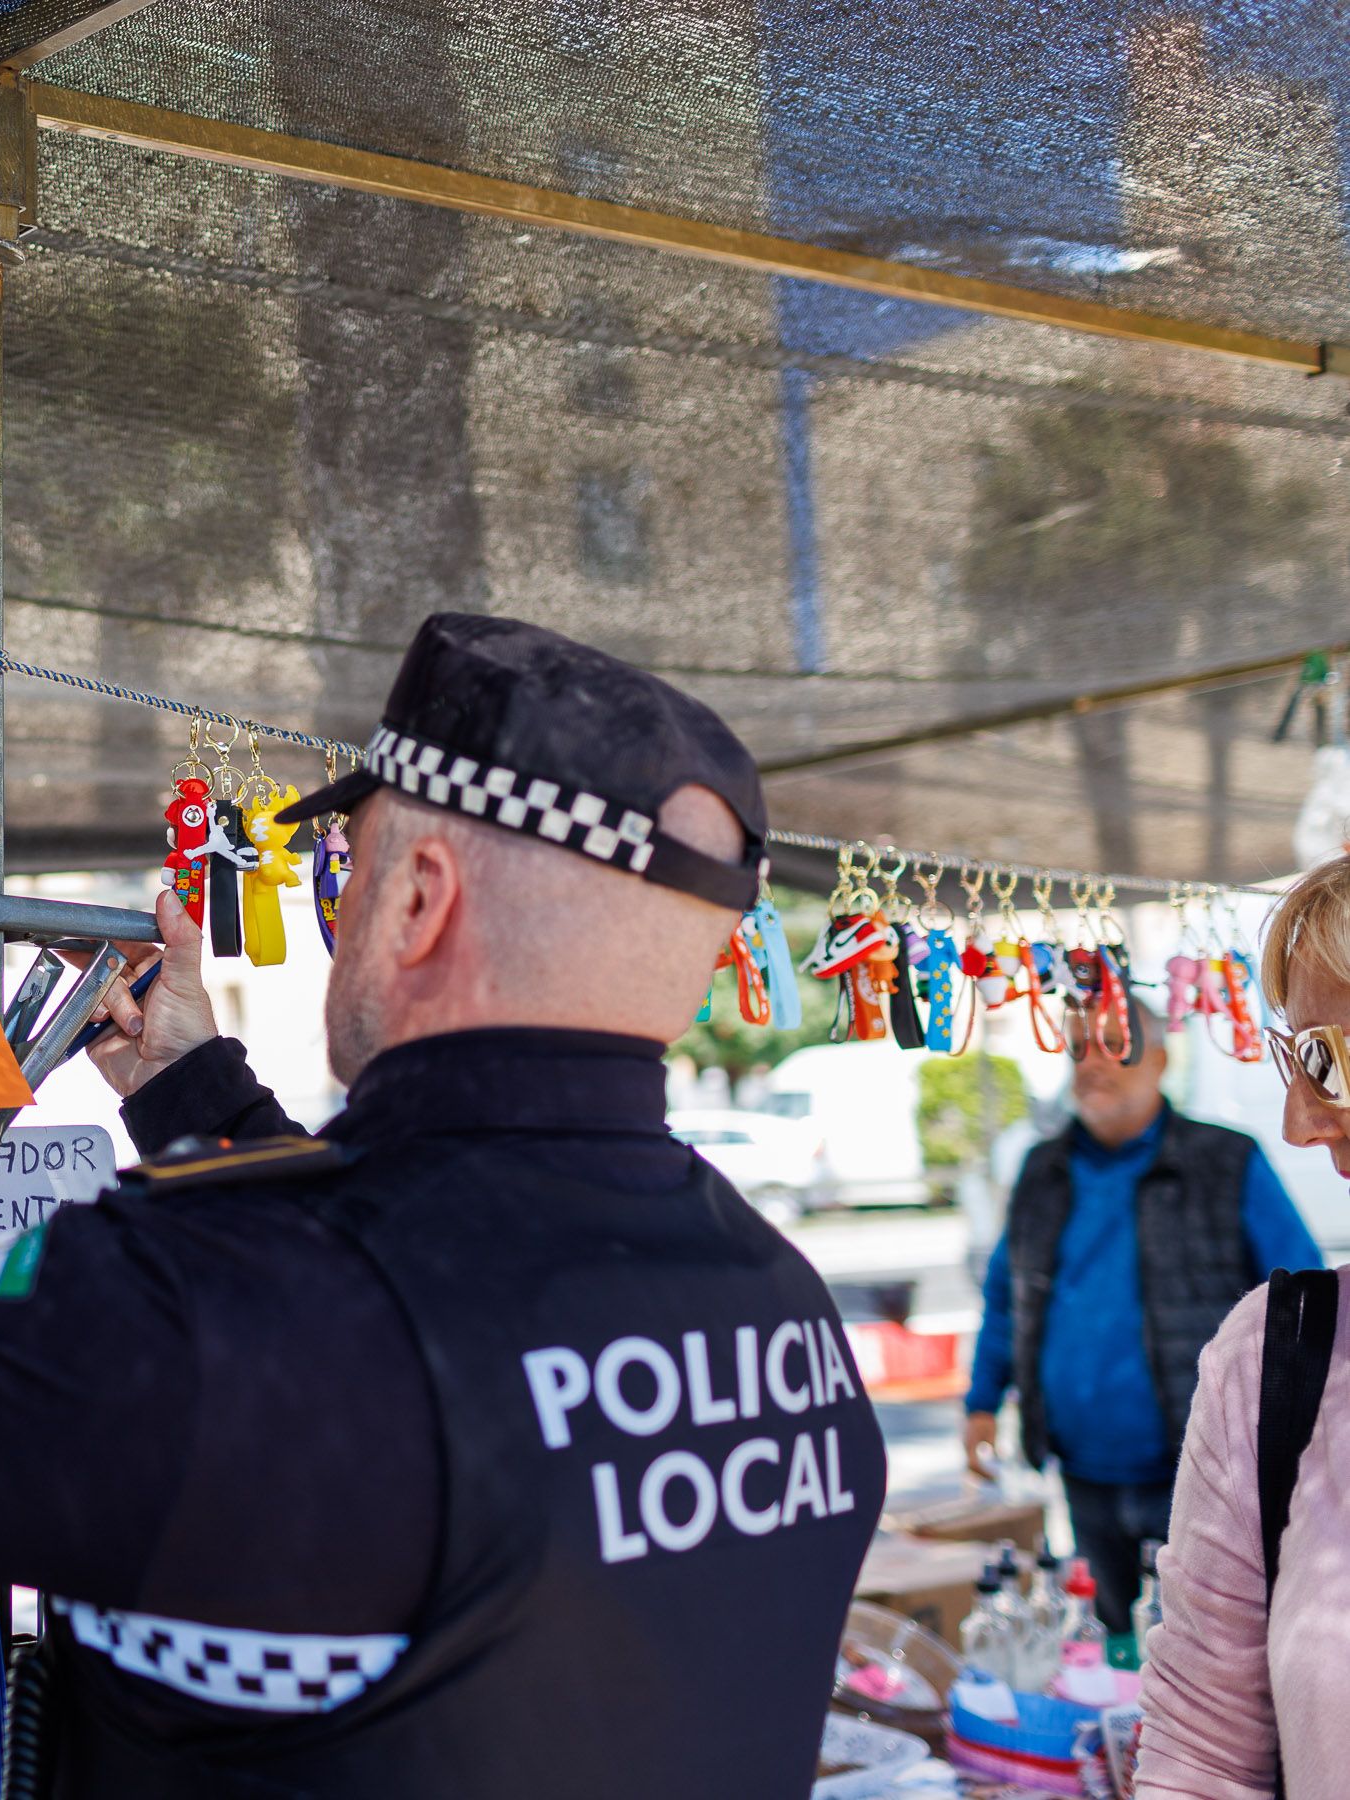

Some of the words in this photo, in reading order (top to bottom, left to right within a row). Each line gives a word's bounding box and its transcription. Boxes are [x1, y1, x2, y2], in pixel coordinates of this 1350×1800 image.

[177, 862, 190, 906] ARIO
[189, 860, 202, 903] SUER
[522, 1318, 856, 1450] POLICIA
[591, 1426, 855, 1564] LOCAL
